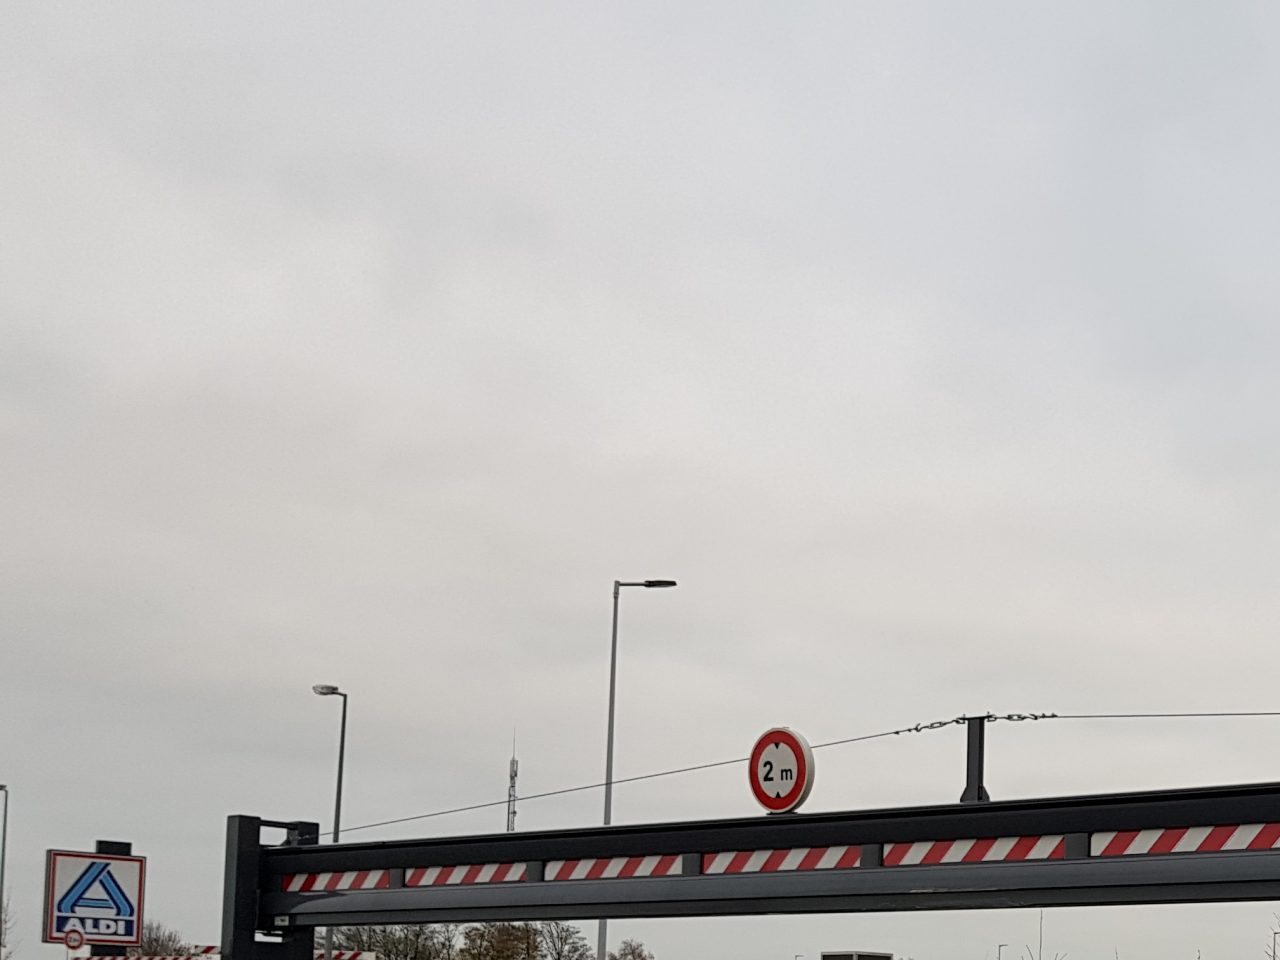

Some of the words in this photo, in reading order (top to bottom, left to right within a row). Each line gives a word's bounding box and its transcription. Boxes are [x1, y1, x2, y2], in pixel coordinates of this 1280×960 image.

[763, 760, 774, 782] 2
[780, 768, 793, 781] m
[63, 918, 126, 935] ALDI
